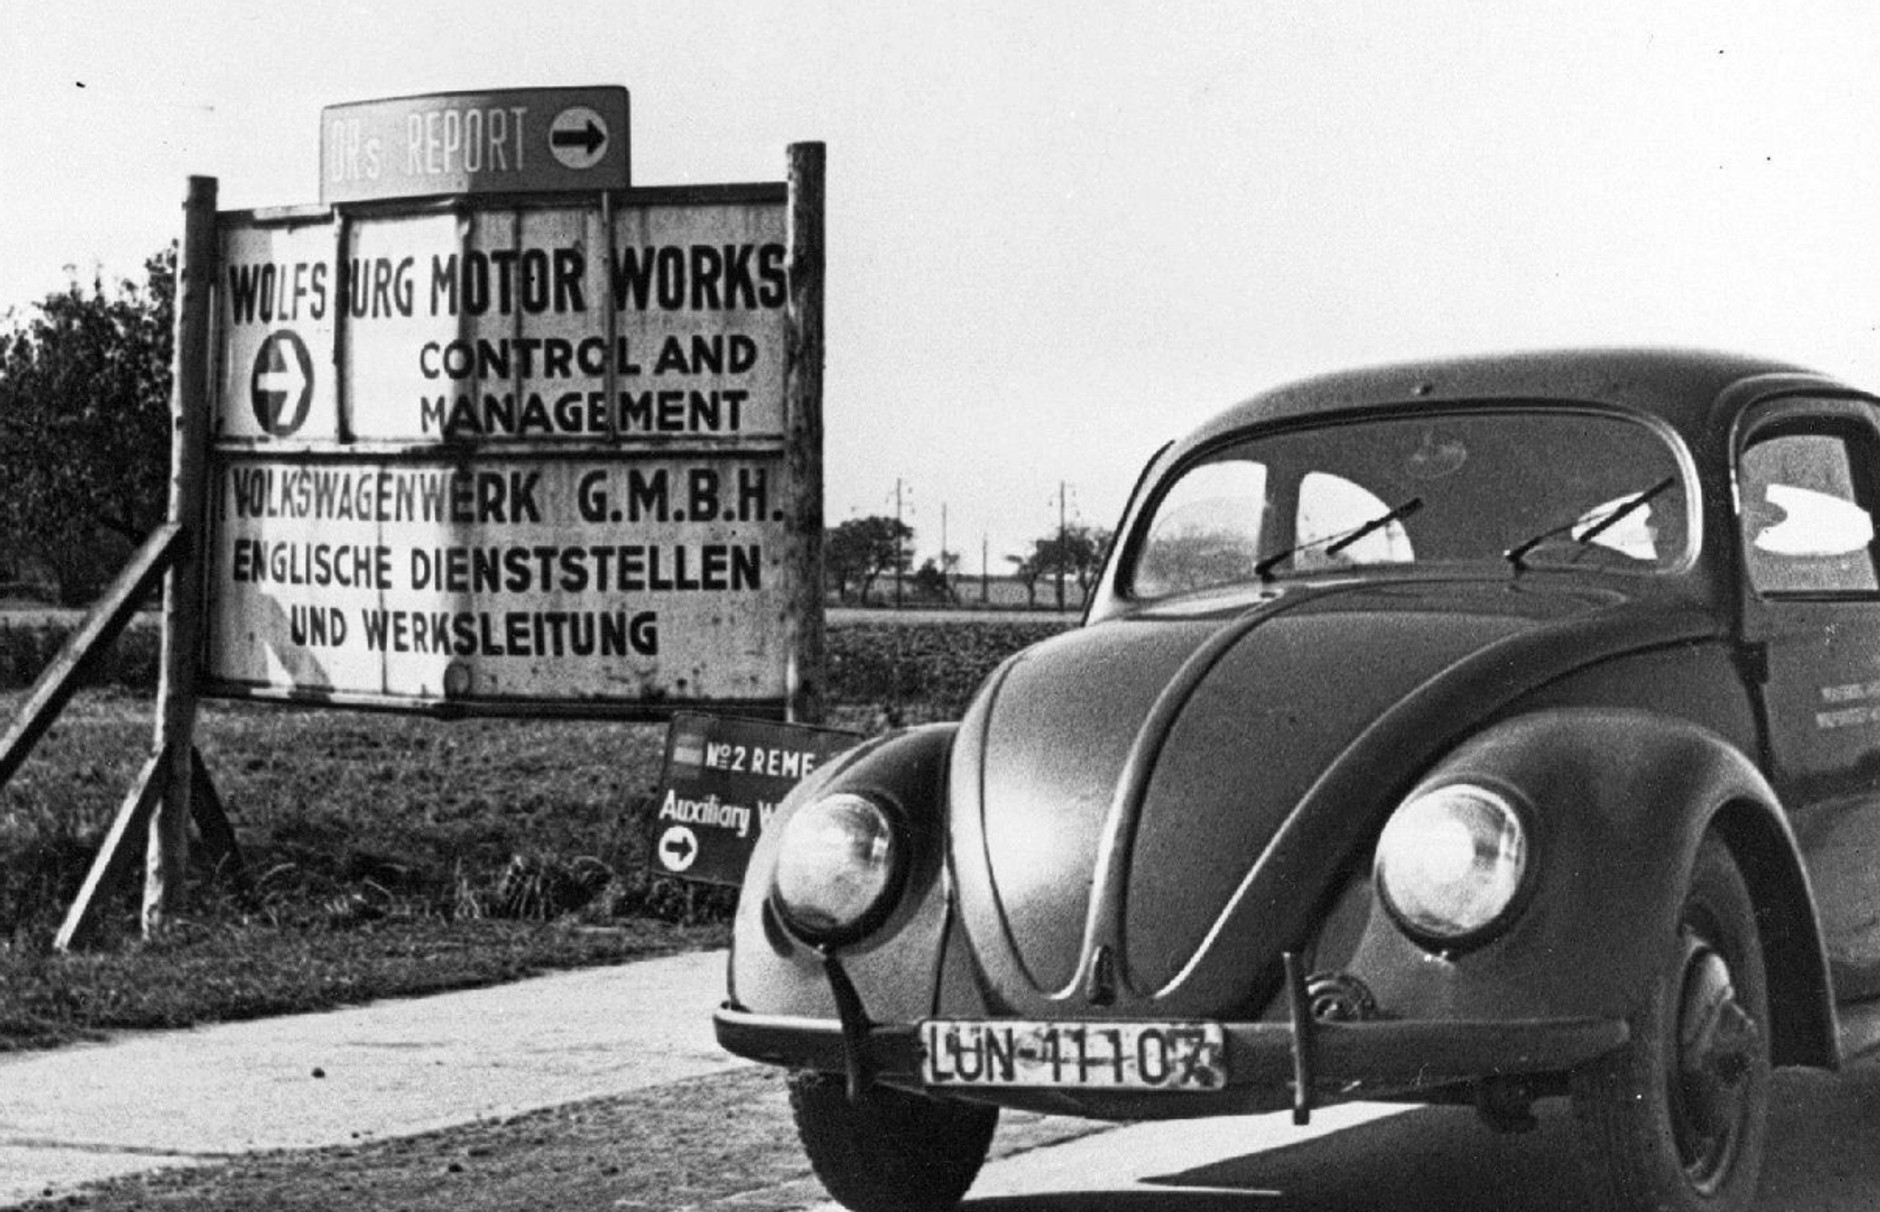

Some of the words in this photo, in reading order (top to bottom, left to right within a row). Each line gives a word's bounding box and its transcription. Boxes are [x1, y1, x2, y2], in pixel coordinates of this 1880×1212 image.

[408, 106, 529, 175] REPORT
[430, 247, 586, 318] MOTOR
[611, 243, 787, 311] WORKS
[420, 335, 641, 380] CONTROL
[653, 334, 758, 375] AND
[421, 390, 750, 434] MANAGEMENT
[232, 466, 542, 523] VOLKSWAGENWERK
[577, 468, 784, 523] G.M.B.H.
[233, 539, 392, 590] ENGLISCHE
[411, 545, 761, 593] DIENSTSTELLEN
[291, 604, 347, 647] UND
[361, 608, 658, 657] WERKSLEITUNG
[658, 789, 751, 837] Auxiliary
